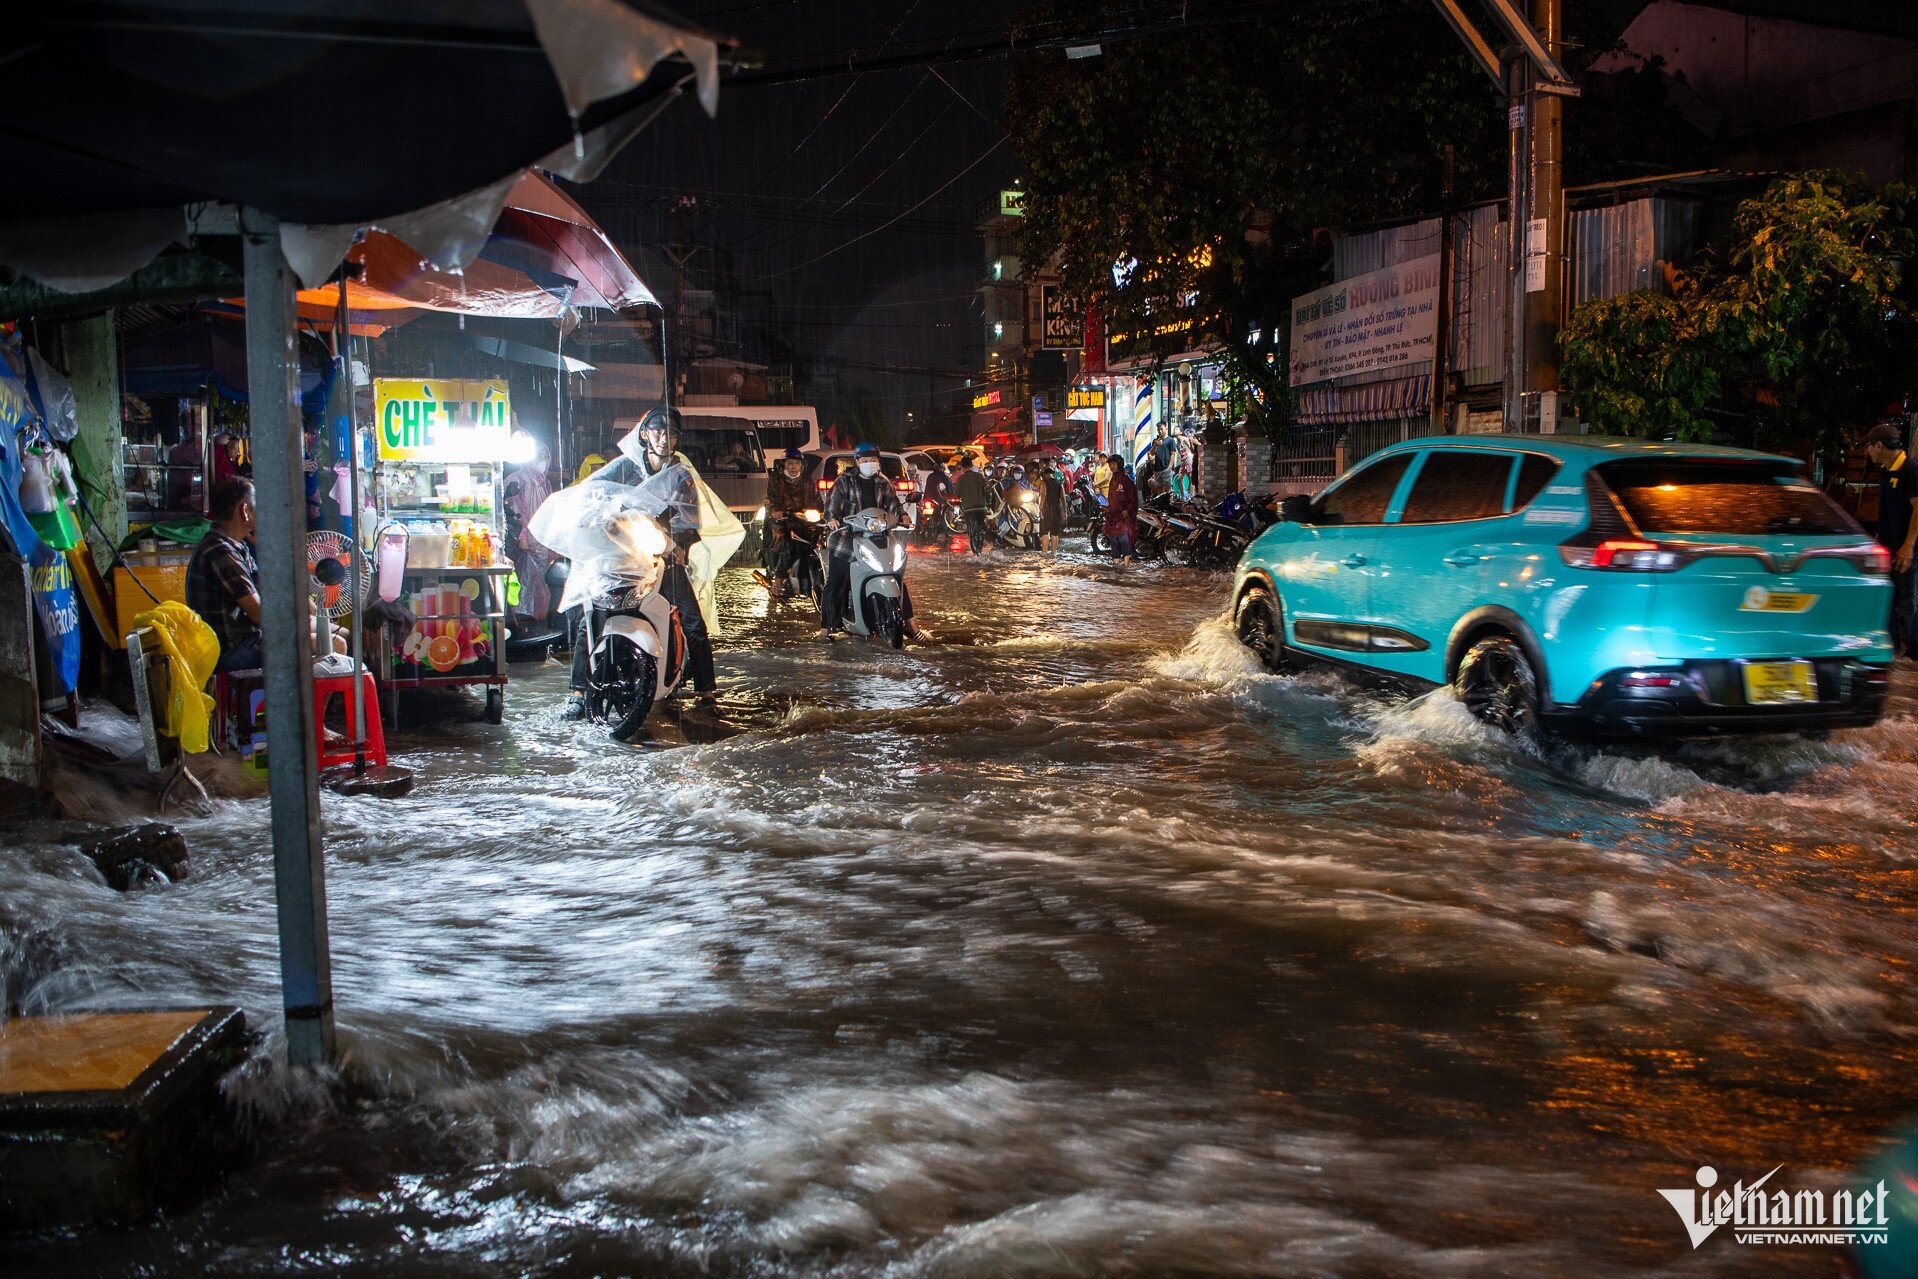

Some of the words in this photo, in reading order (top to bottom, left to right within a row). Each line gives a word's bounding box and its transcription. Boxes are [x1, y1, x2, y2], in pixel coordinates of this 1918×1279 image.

[1333, 288, 1347, 314] SỐ
[1376, 308, 1386, 324] SỐ
[1407, 304, 1418, 318] TẠI
[384, 384, 437, 449] CHÈ
